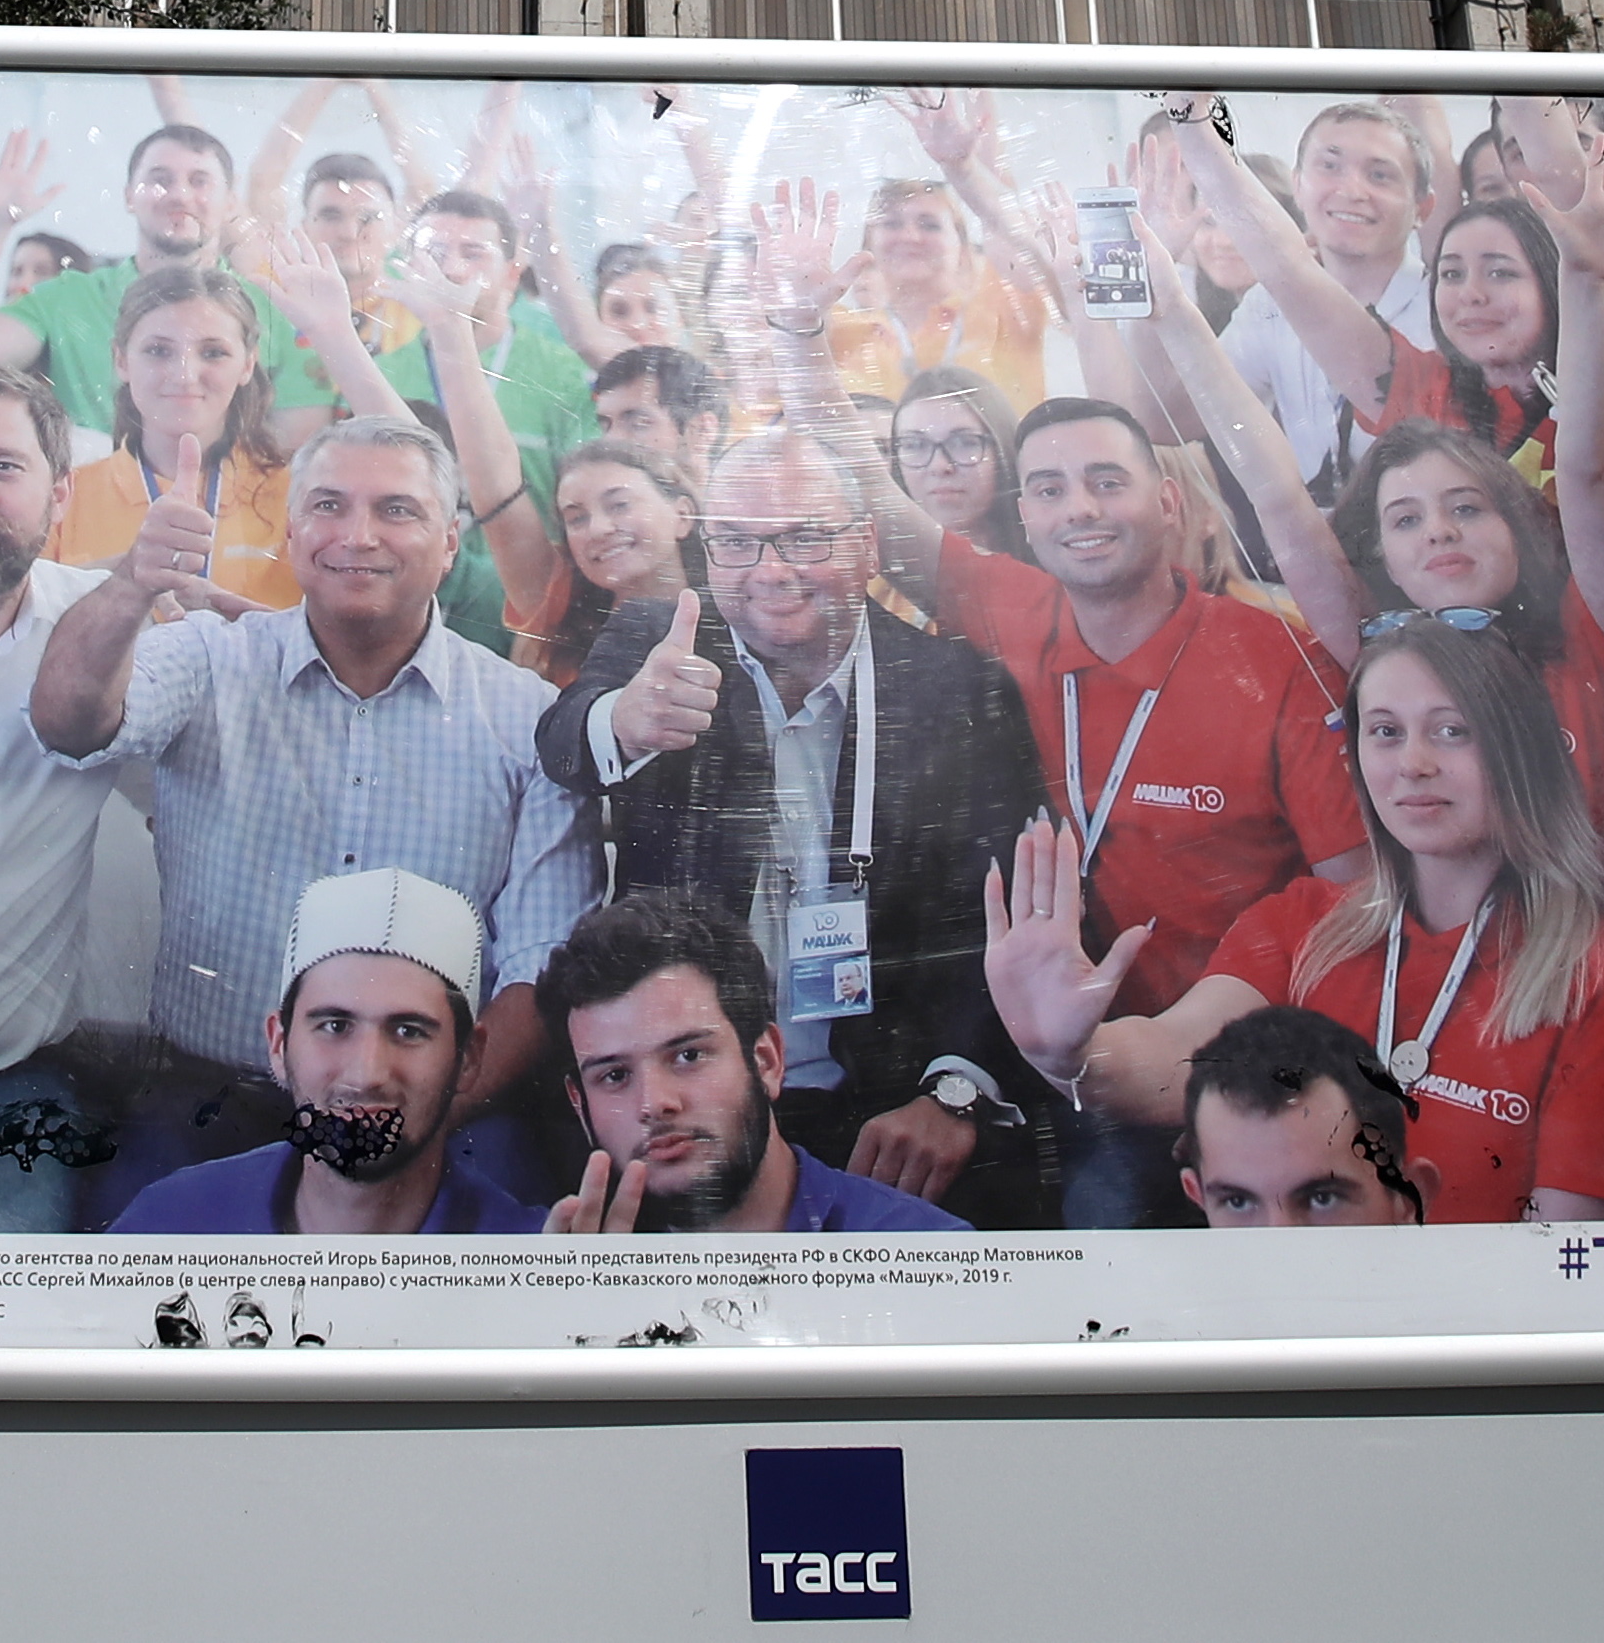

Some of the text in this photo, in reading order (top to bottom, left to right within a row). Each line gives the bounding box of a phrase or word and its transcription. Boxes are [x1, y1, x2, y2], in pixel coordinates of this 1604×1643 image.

[1192, 785, 1225, 814] 10
[812, 910, 840, 931] 10
[802, 932, 853, 951] МАШУК
[1490, 1089, 1530, 1125] 10
[15, 1254, 93, 1265] агентства
[98, 1254, 118, 1265] по
[122, 1254, 173, 1267] делам
[178, 1251, 323, 1268] национальностей
[329, 1251, 377, 1268] Игорь
[382, 1251, 456, 1268] Баринов,
[461, 1250, 576, 1265] полномочный
[582, 1254, 700, 1268] представитель
[705, 1253, 797, 1268] президента
[802, 1249, 825, 1265] РФ
[830, 1253, 838, 1263] в
[843, 1249, 890, 1264] СКФО
[895, 1249, 979, 1266] Александр
[984, 1248, 1083, 1262] Матовников
[28, 1272, 84, 1290] Сергей
[90, 1272, 174, 1286] Михайлов
[179, 1272, 193, 1289] (в
[199, 1276, 256, 1290] центре
[260, 1276, 306, 1288] слева
[311, 1272, 385, 1290] направо)
[390, 1276, 397, 1286] с
[401, 1275, 505, 1290] участниками
[526, 1272, 692, 1290] Северо-Кавказского
[812, 1271, 875, 1289] форума
[880, 1270, 958, 1288] «Машук»,
[963, 1269, 999, 1283] 2019
[1004, 1272, 1012, 1282] г.
